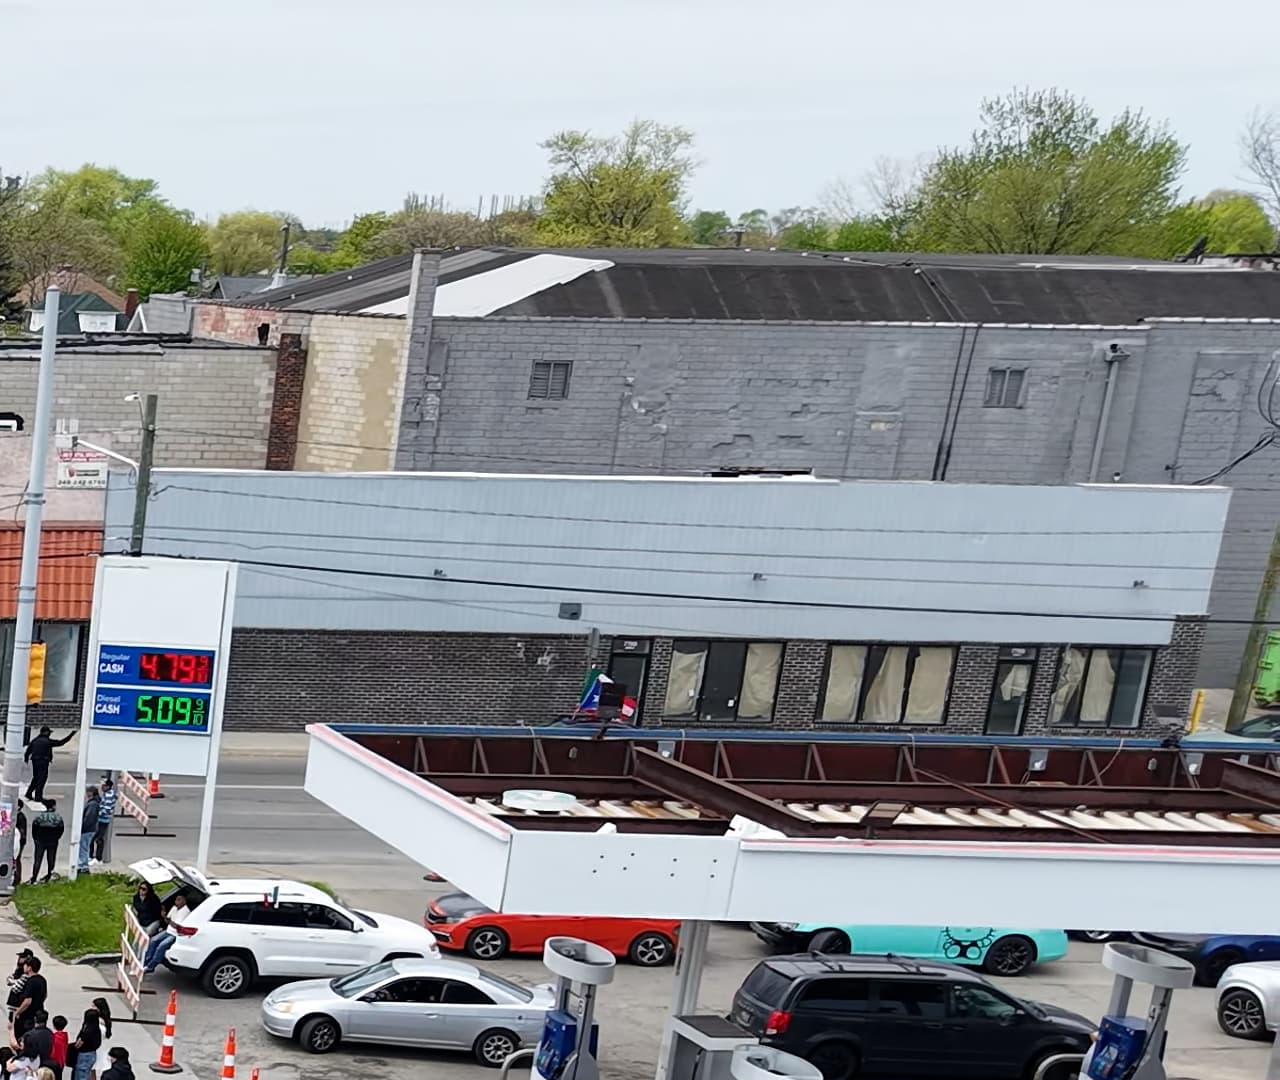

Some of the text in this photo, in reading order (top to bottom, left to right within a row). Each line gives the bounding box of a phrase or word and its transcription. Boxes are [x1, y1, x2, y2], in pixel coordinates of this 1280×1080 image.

[100, 651, 130, 662] Regular
[99, 663, 124, 674] CASH
[95, 703, 120, 714] CASH
[97, 694, 121, 703] Diesel
[137, 695, 192, 725] 5.09
